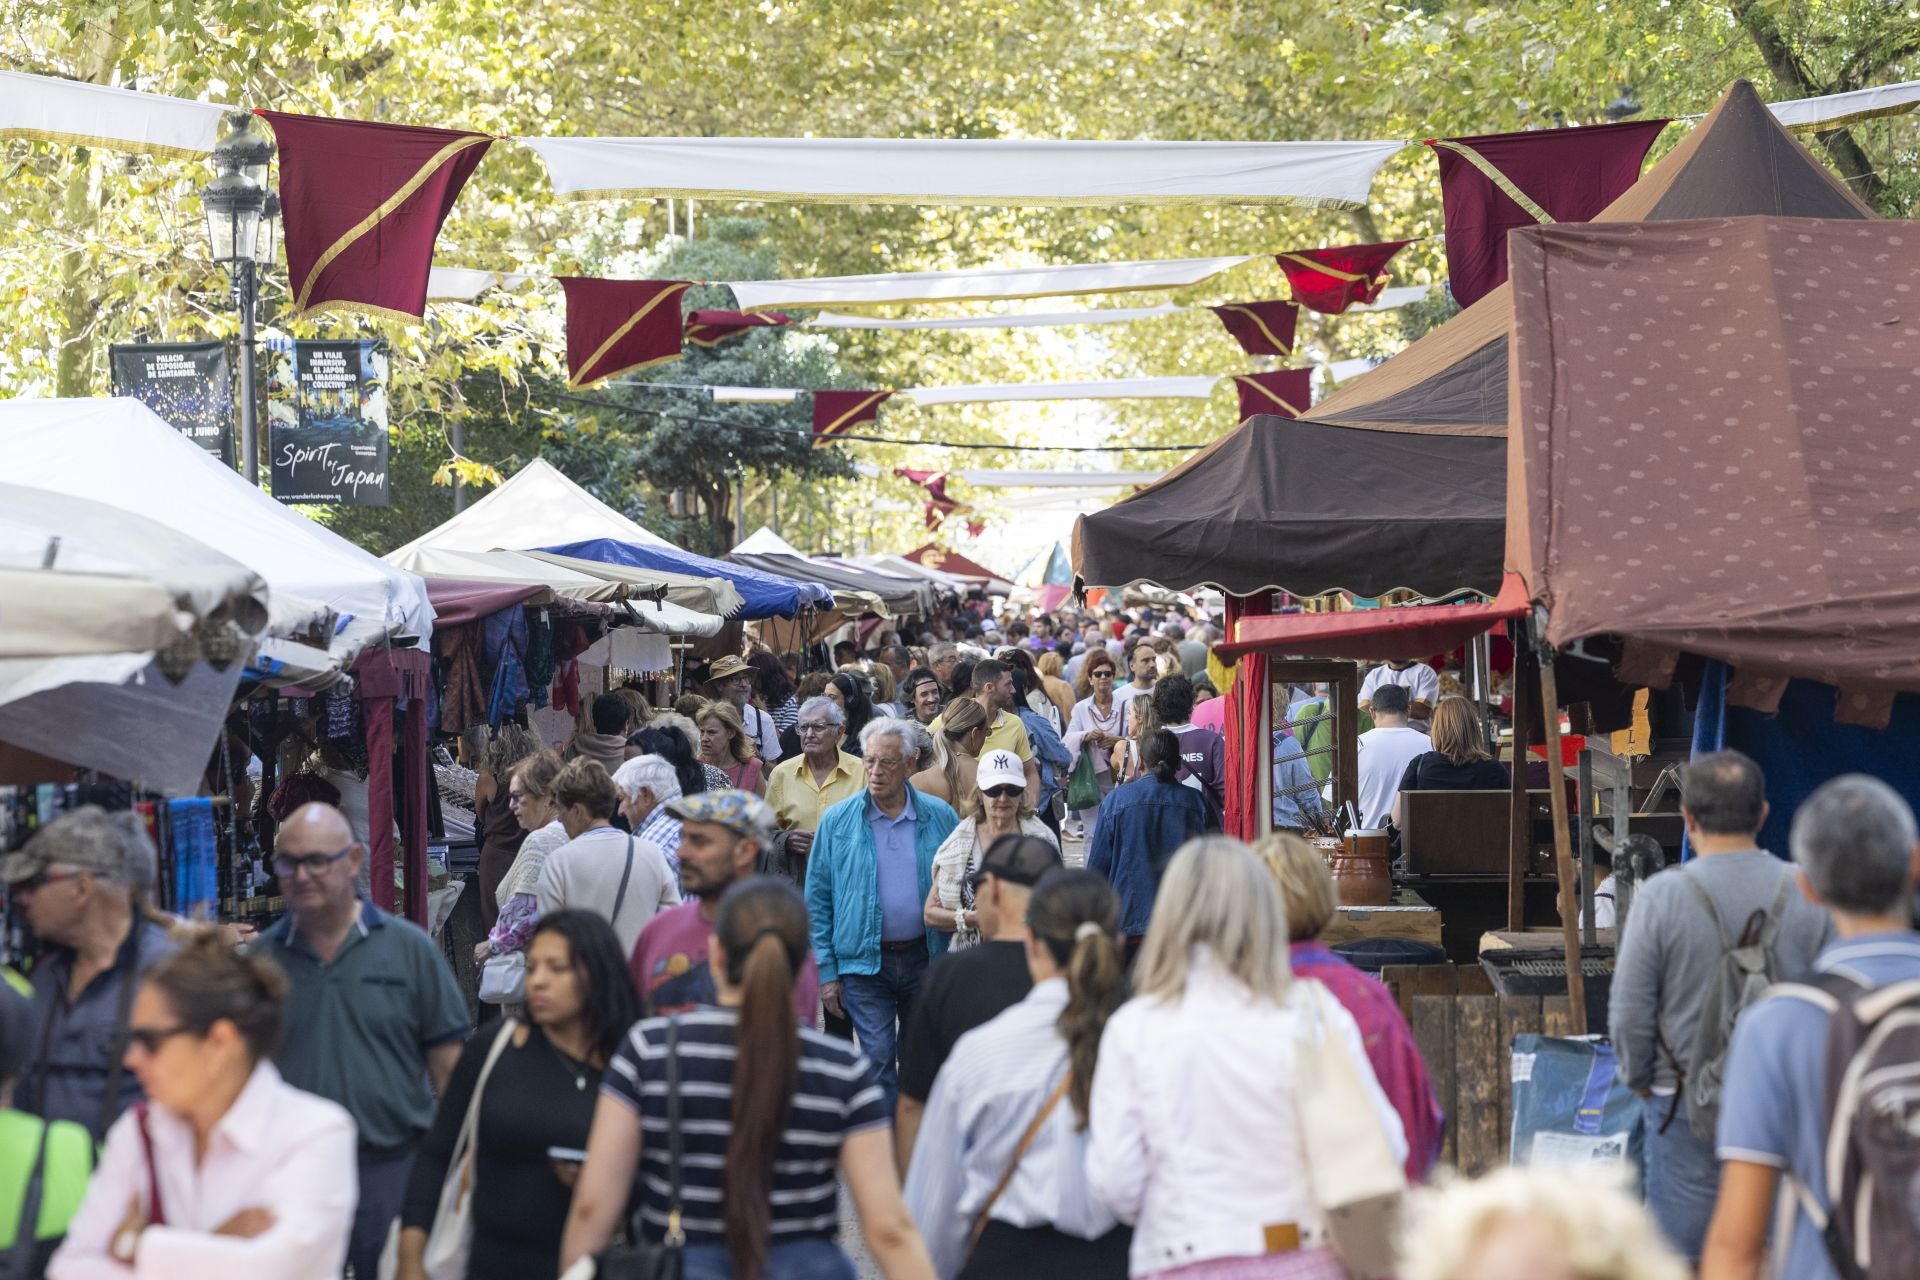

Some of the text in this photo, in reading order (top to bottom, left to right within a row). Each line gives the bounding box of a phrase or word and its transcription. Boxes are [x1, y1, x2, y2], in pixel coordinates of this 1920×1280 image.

[156, 354, 184, 363] PALACIO
[310, 359, 346, 367] INMERSIVO
[146, 363, 156, 371] DE
[148, 369, 196, 378] DE SANTANDER
[302, 374, 356, 382] DEL IMAGINARIO
[182, 426, 220, 437] DE JUNIO
[276, 442, 385, 498] Spirit of Japan
[1180, 752, 1204, 762] NES
